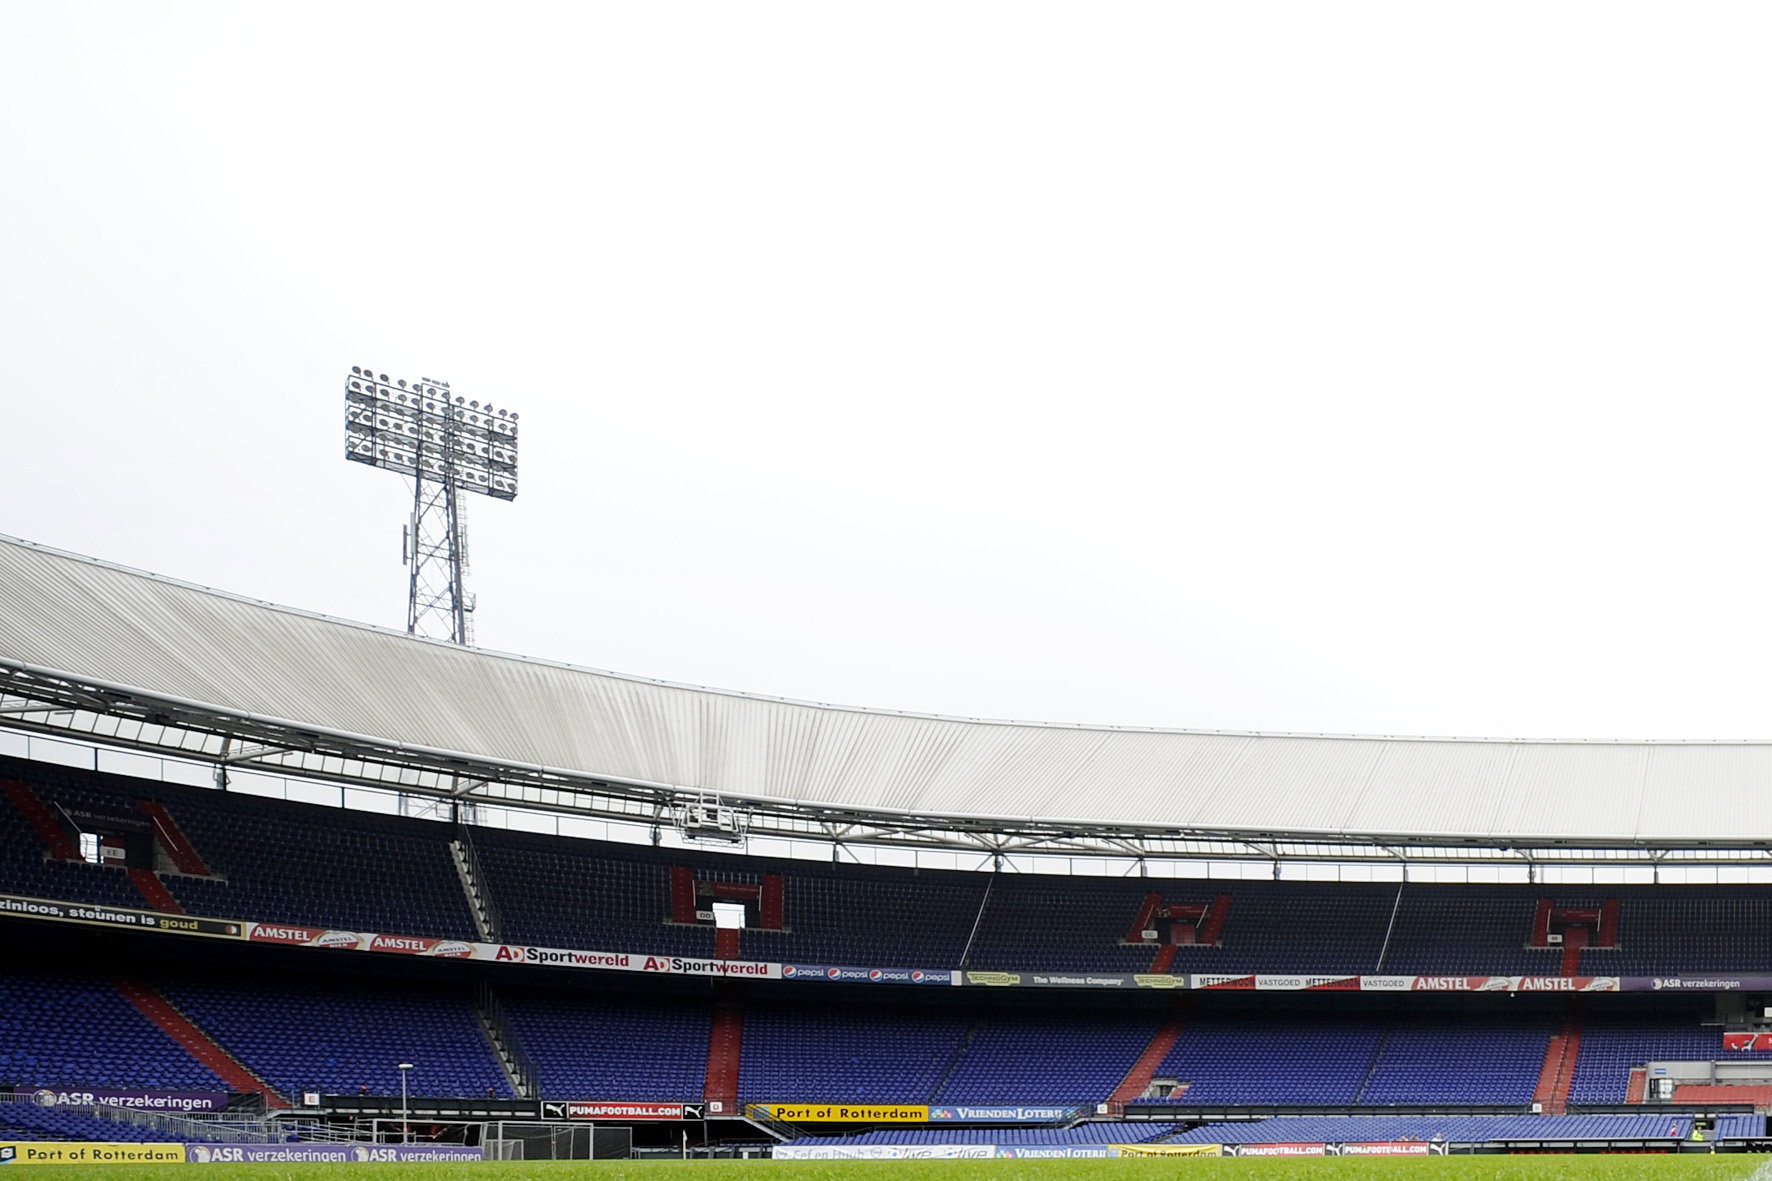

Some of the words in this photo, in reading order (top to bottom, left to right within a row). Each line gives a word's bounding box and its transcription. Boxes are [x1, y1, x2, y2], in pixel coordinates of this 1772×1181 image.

[141, 914, 155, 925] is
[160, 917, 199, 931] goud
[255, 926, 310, 942] AMSTEL
[374, 937, 427, 951] AMSTEL
[527, 948, 630, 968] Sportwereld
[672, 959, 768, 975] Sportwereld
[797, 966, 824, 978] pepsi
[842, 968, 868, 979] pepsi
[883, 969, 909, 980] pepsi
[925, 970, 950, 981] pepsi
[1033, 976, 1049, 984] The
[1051, 976, 1085, 985] Wellness
[1087, 976, 1120, 986] Company
[1258, 978, 1302, 987] VASTGOED
[1363, 979, 1406, 988] VASTGOED
[1416, 978, 1471, 990] AMSTEL
[1522, 978, 1575, 990] AMSTEL
[1662, 979, 1681, 988] ASR
[1683, 979, 1741, 990] verzekeringen
[58, 1092, 94, 1105] ASR
[99, 1095, 213, 1111] verzekeringen
[569, 1102, 681, 1116] PUMAFOOTBALL.COM
[776, 1107, 809, 1119] Port
[817, 1107, 831, 1119] of
[839, 1107, 922, 1118] Rotterdam
[27, 1148, 64, 1161] Port
[69, 1148, 86, 1161] of
[93, 1148, 179, 1161] Rotterdam
[211, 1149, 243, 1162] ASR
[248, 1150, 346, 1162] verzekeringen
[369, 1149, 396, 1162] ASR
[400, 1151, 481, 1162] verzekeringen
